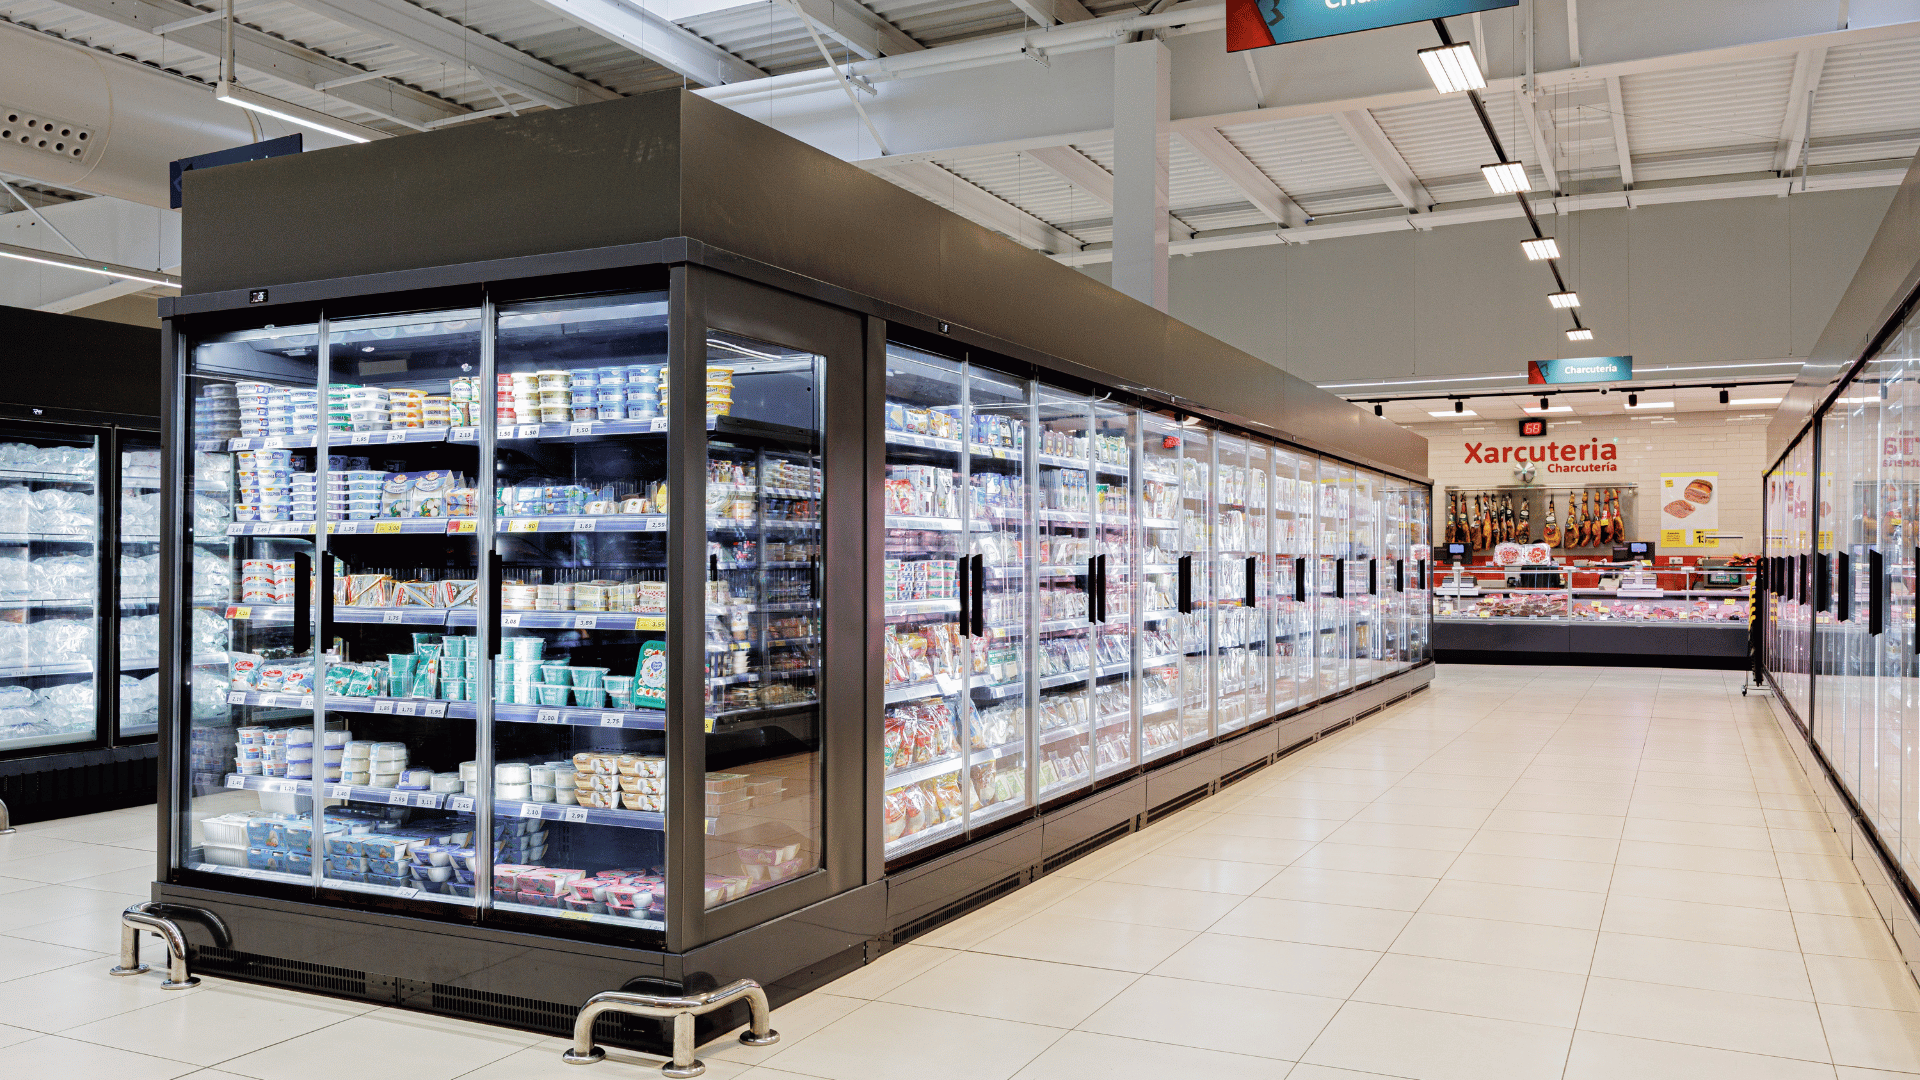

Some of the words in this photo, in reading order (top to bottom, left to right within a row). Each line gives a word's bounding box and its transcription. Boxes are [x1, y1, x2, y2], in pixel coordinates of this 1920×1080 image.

[1564, 364, 1618, 375] Charcutería
[1464, 437, 1617, 464] Xarcuteria
[1547, 461, 1617, 473] Charcutería
